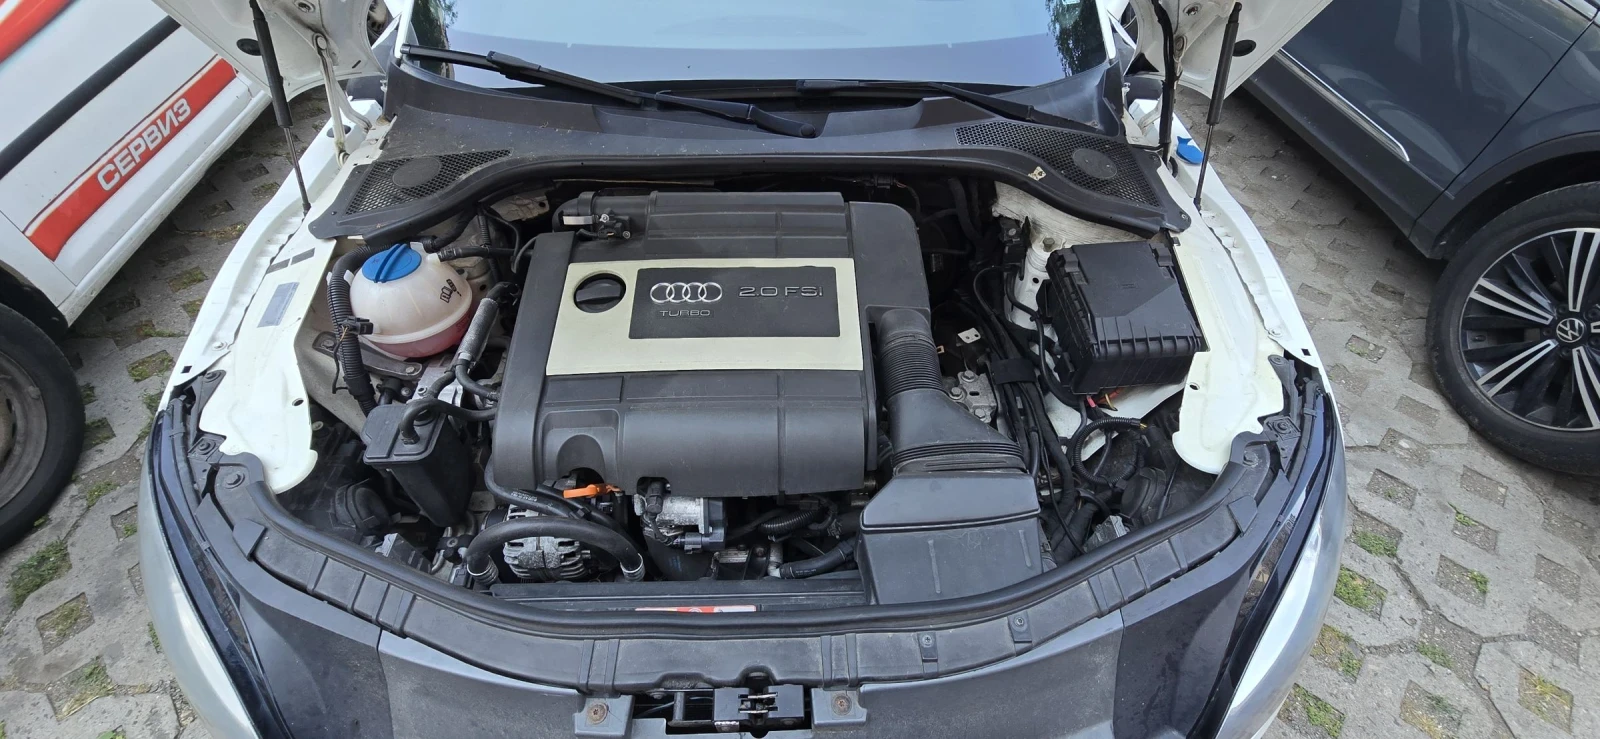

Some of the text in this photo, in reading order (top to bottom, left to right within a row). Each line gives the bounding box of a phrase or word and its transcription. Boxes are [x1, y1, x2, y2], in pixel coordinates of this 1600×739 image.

[97, 98, 191, 191] СЕРВИЗ
[739, 286, 778, 297] 2.0
[659, 309, 711, 317] TURBO
